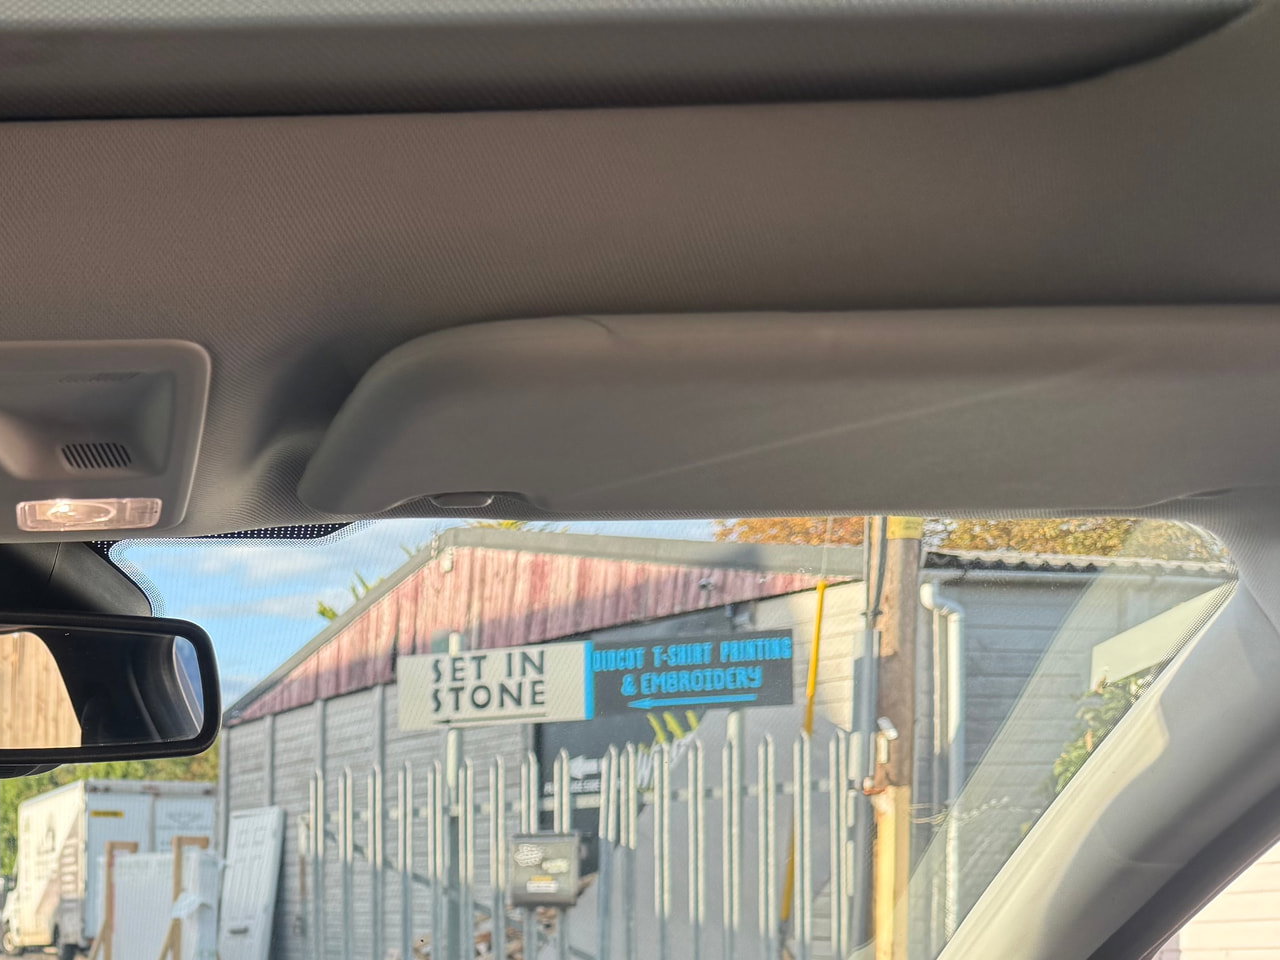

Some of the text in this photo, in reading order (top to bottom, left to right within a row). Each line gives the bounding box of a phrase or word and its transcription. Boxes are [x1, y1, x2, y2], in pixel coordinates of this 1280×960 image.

[432, 650, 545, 683] SET IN
[593, 637, 793, 672] DIDCOT T-SHIRT PRINTING
[432, 680, 545, 712] STONE
[621, 666, 763, 695] & EMBROIDERY
